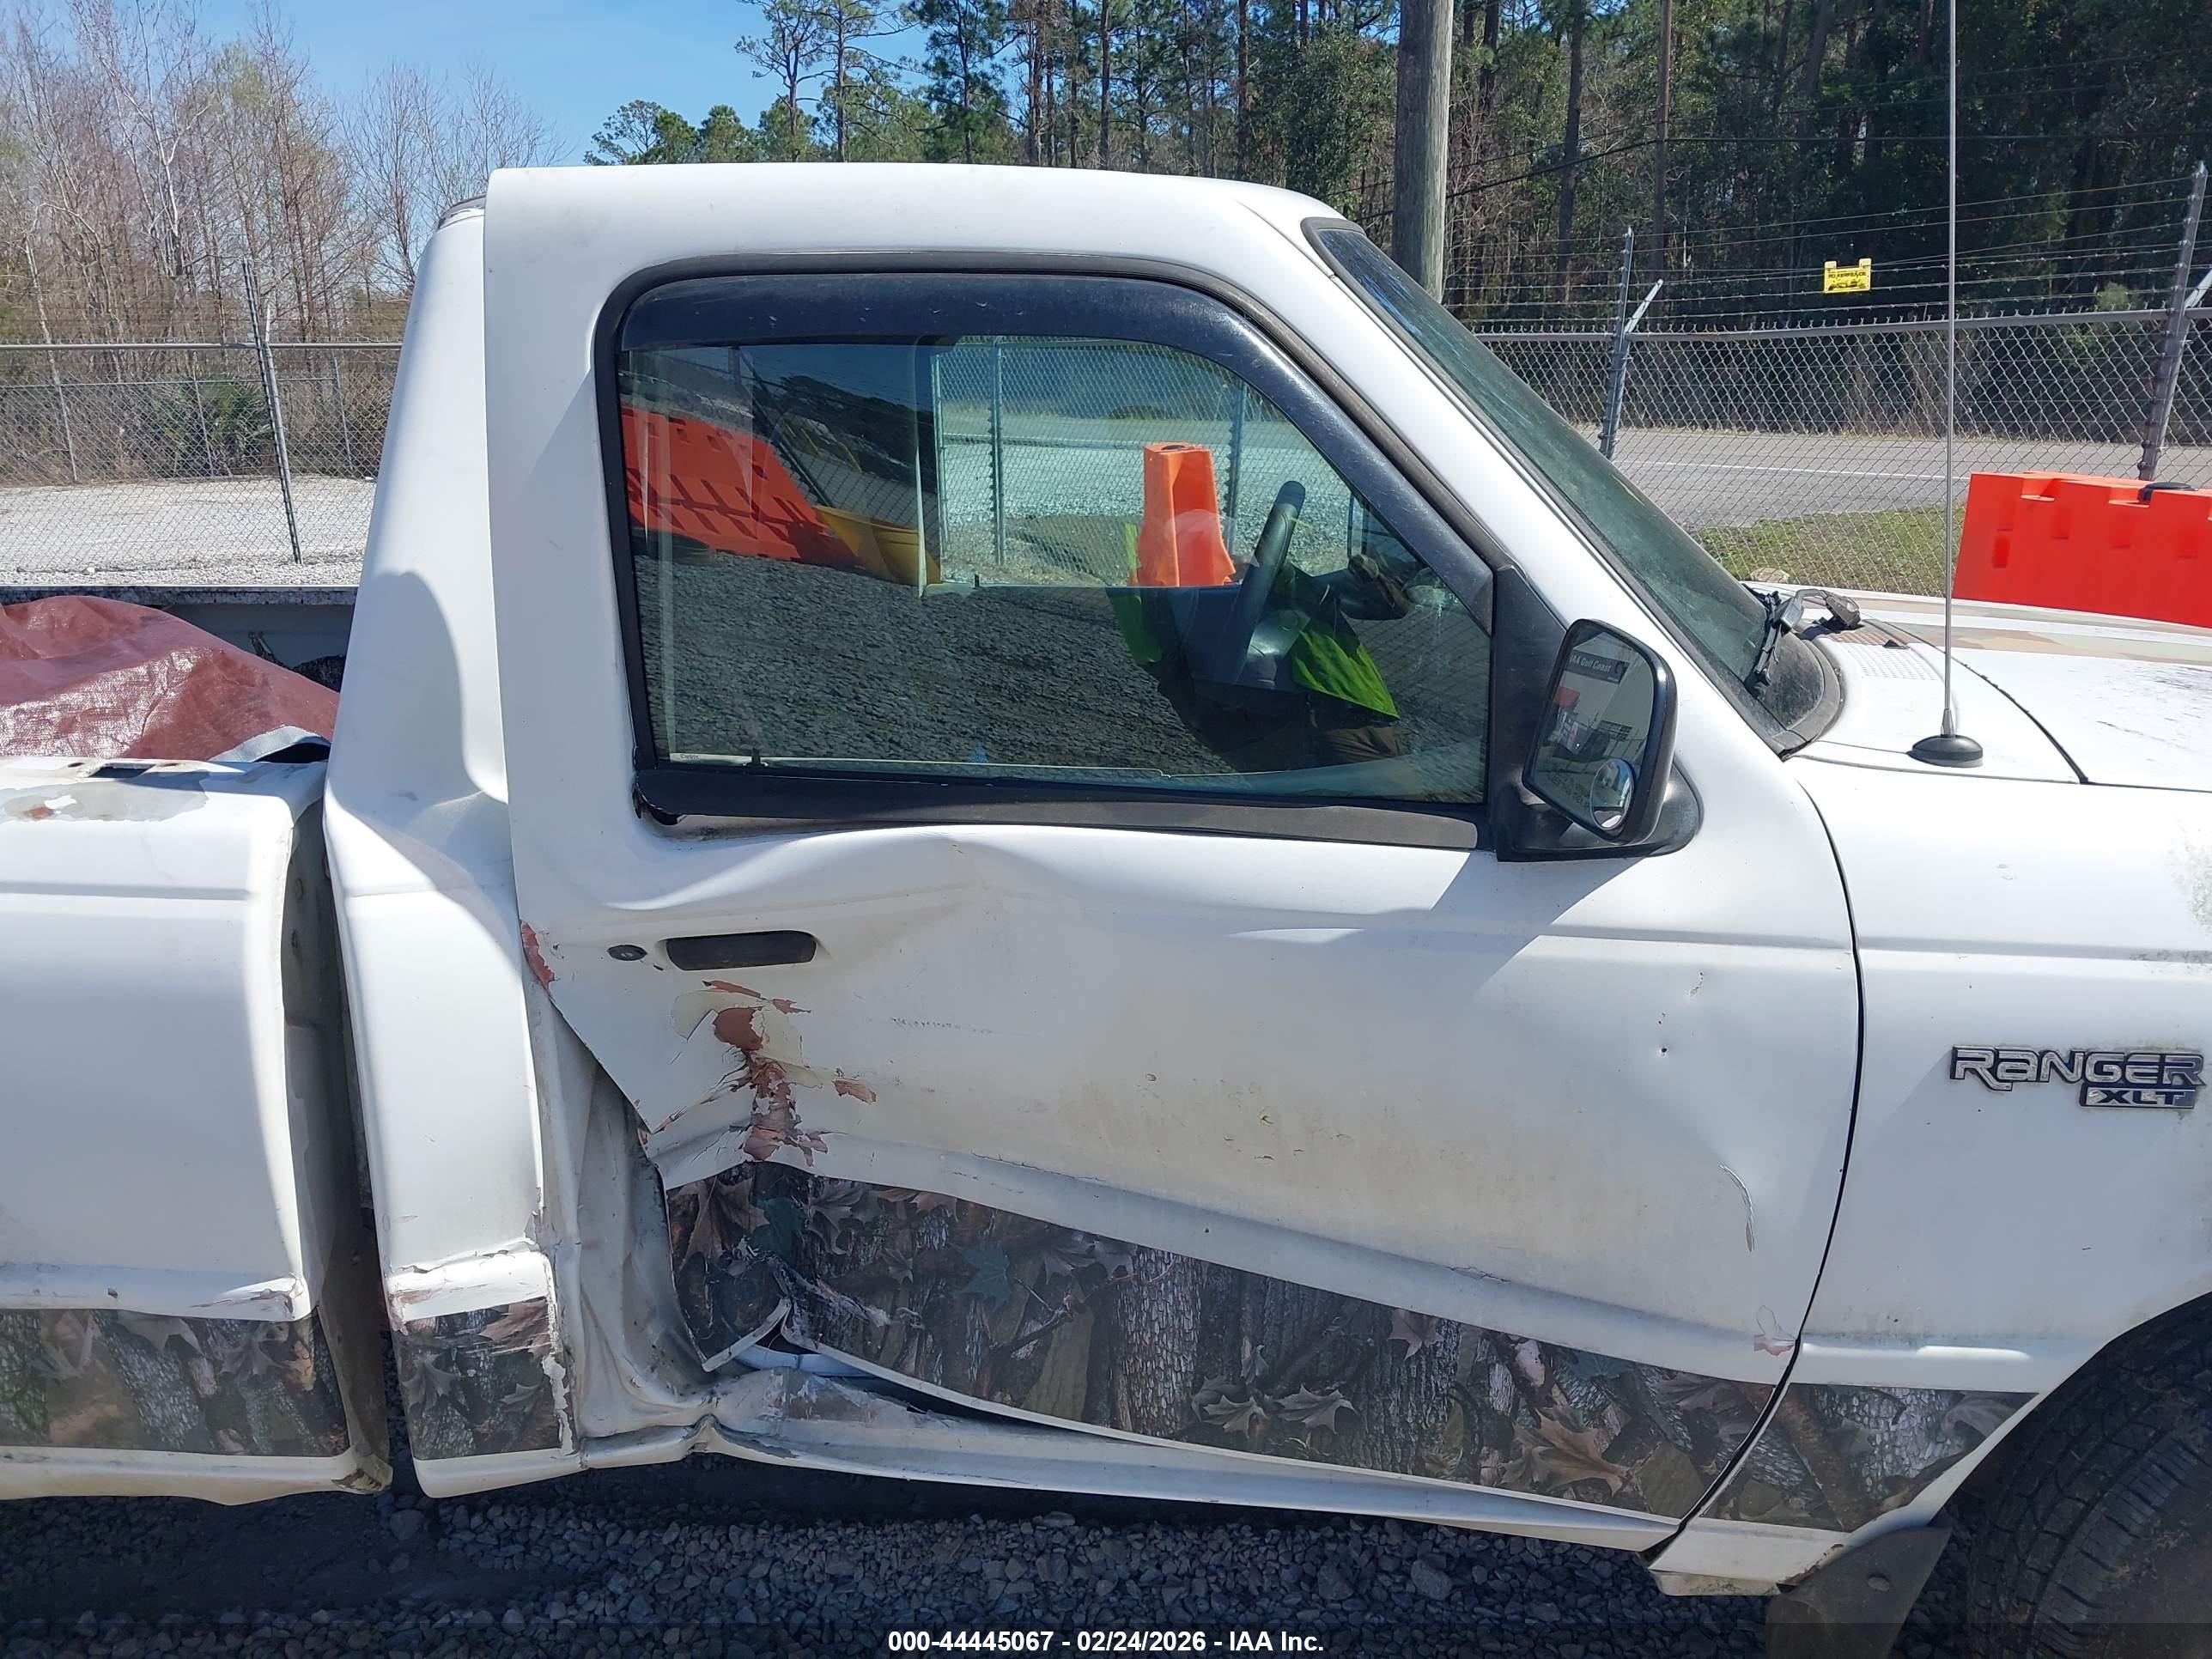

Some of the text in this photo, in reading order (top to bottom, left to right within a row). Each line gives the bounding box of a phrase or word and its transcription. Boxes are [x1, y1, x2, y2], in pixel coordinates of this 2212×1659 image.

[1581, 658, 1594, 667] Gulf
[1593, 660, 1612, 672] Coast
[2096, 1089, 2185, 1105] XLT
